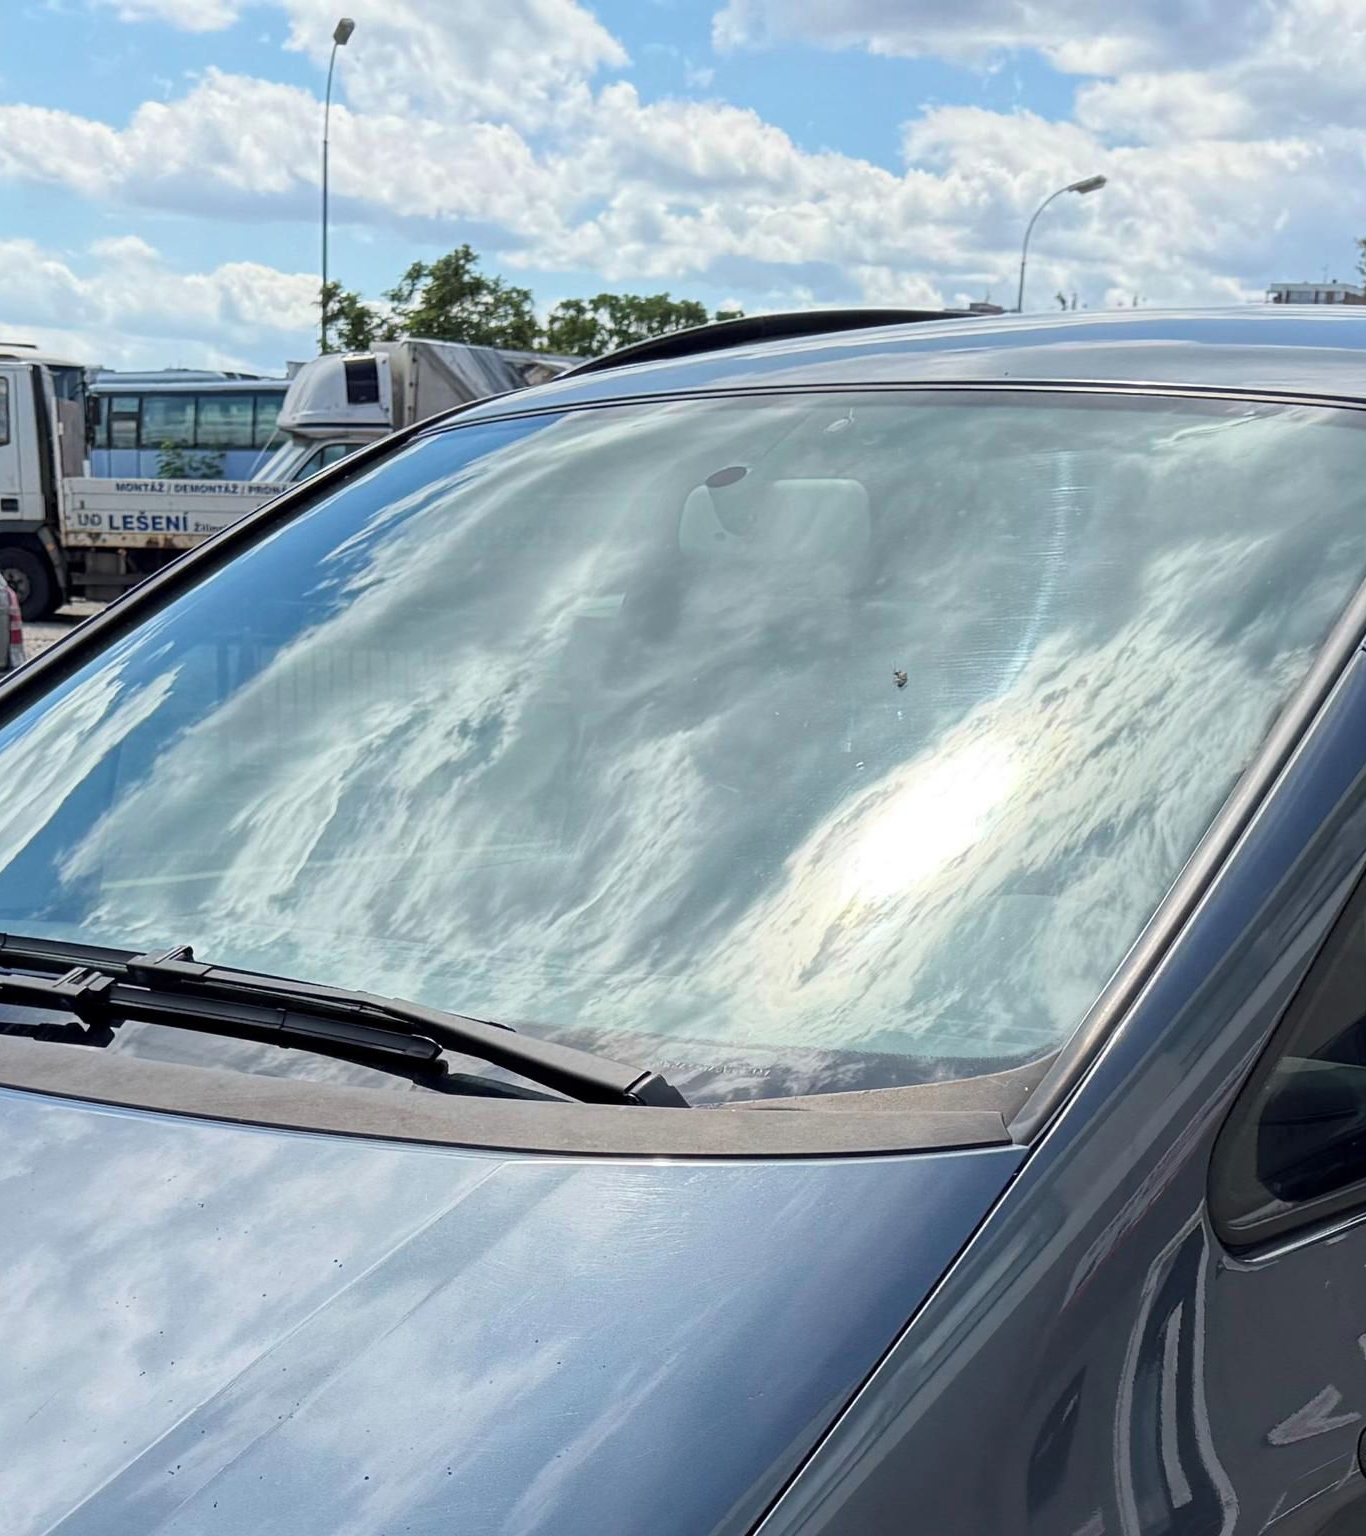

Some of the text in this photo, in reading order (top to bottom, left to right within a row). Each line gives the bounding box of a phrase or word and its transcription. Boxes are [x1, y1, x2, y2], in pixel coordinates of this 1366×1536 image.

[116, 481, 164, 493] MONTÁŽ
[174, 482, 239, 494] DEMONTÁŽ
[108, 511, 189, 532] LEŠENÍ
